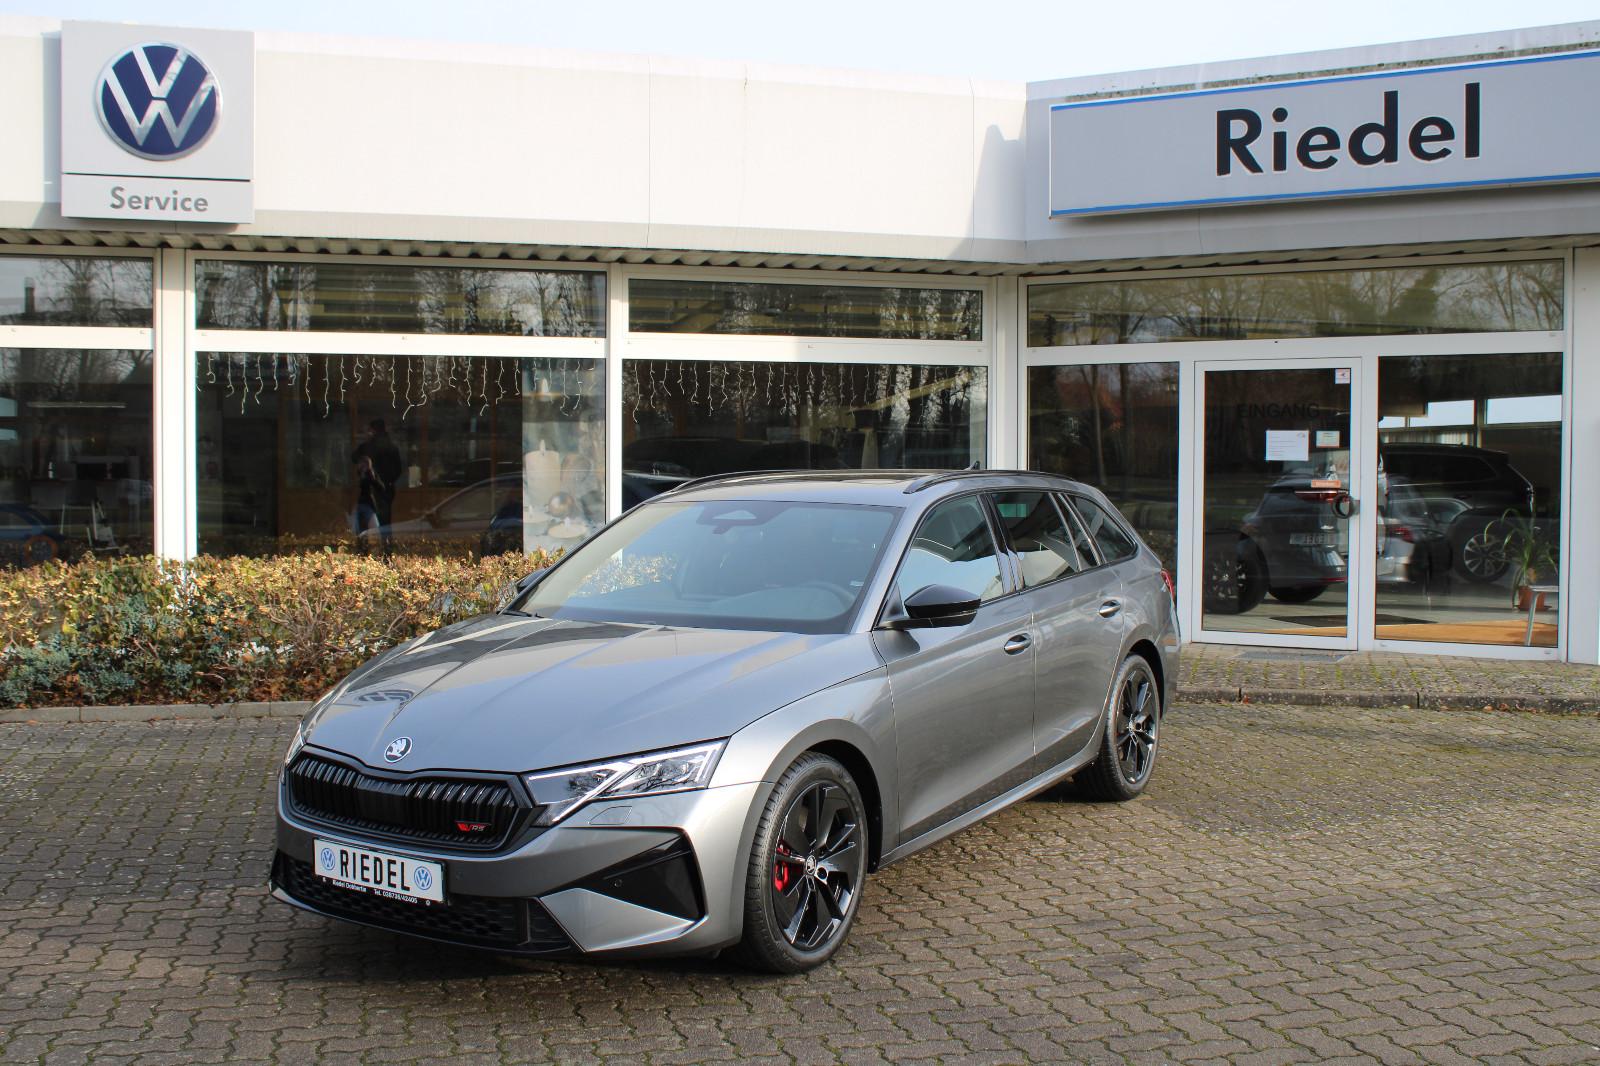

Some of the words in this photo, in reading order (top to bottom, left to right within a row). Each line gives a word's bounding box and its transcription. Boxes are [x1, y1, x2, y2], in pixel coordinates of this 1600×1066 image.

[1216, 82, 1480, 176] Riedel
[110, 186, 209, 212] Service
[1237, 403, 1320, 418] EINGANG
[340, 849, 411, 892] RIEDEL
